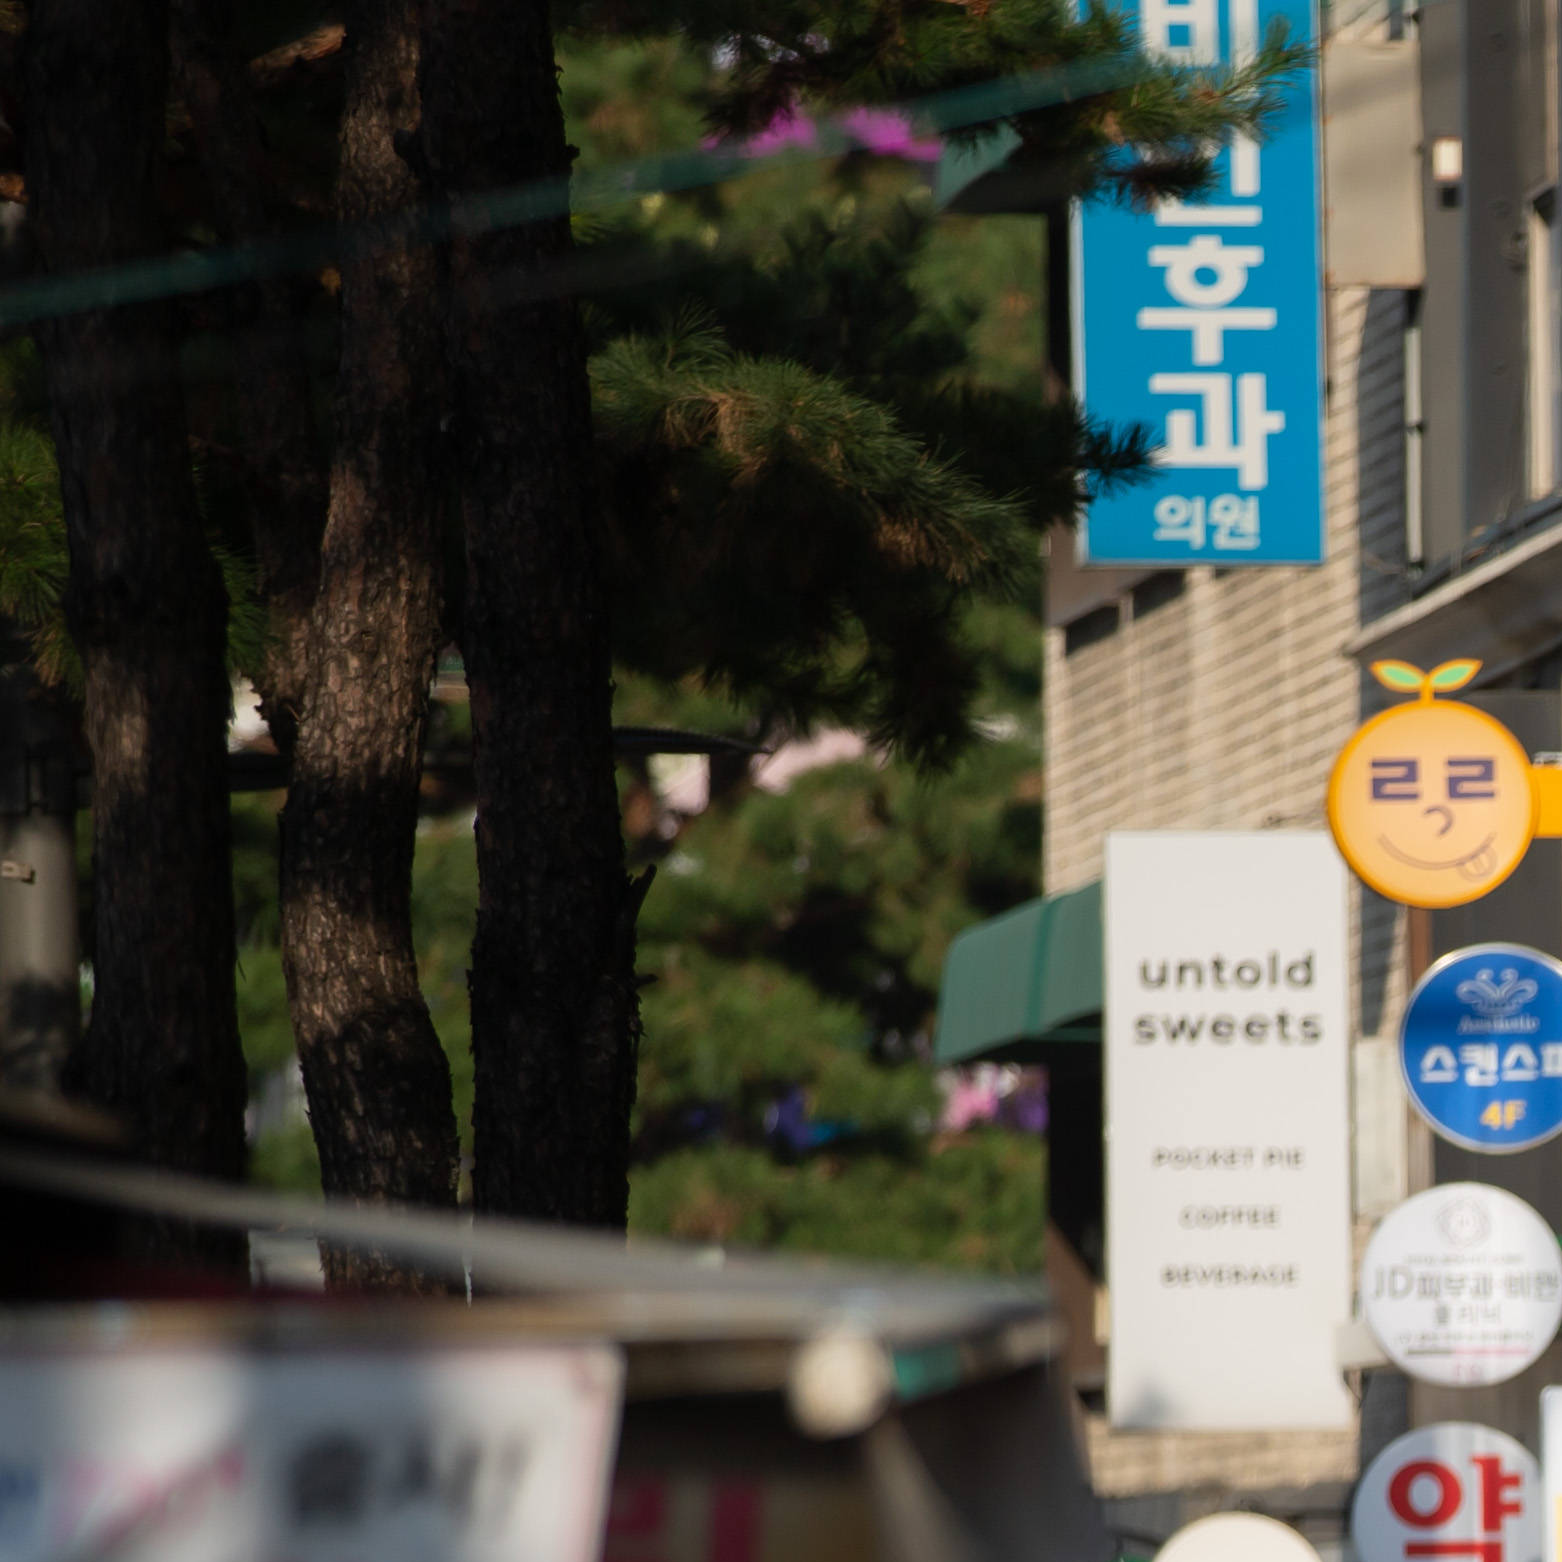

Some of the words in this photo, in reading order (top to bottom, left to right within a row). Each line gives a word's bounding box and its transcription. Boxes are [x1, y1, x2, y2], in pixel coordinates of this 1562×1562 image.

[1154, 494, 1260, 551] 의원
[1139, 951, 1317, 991] untold
[1134, 1010, 1324, 1045] sweets
[1480, 1099, 1527, 1131] 4F
[1153, 1148, 1254, 1170] POCKET
[1263, 1147, 1305, 1169] PIE
[1179, 1206, 1280, 1229] COFFEE
[1160, 1263, 1300, 1288] BEVERAGE
